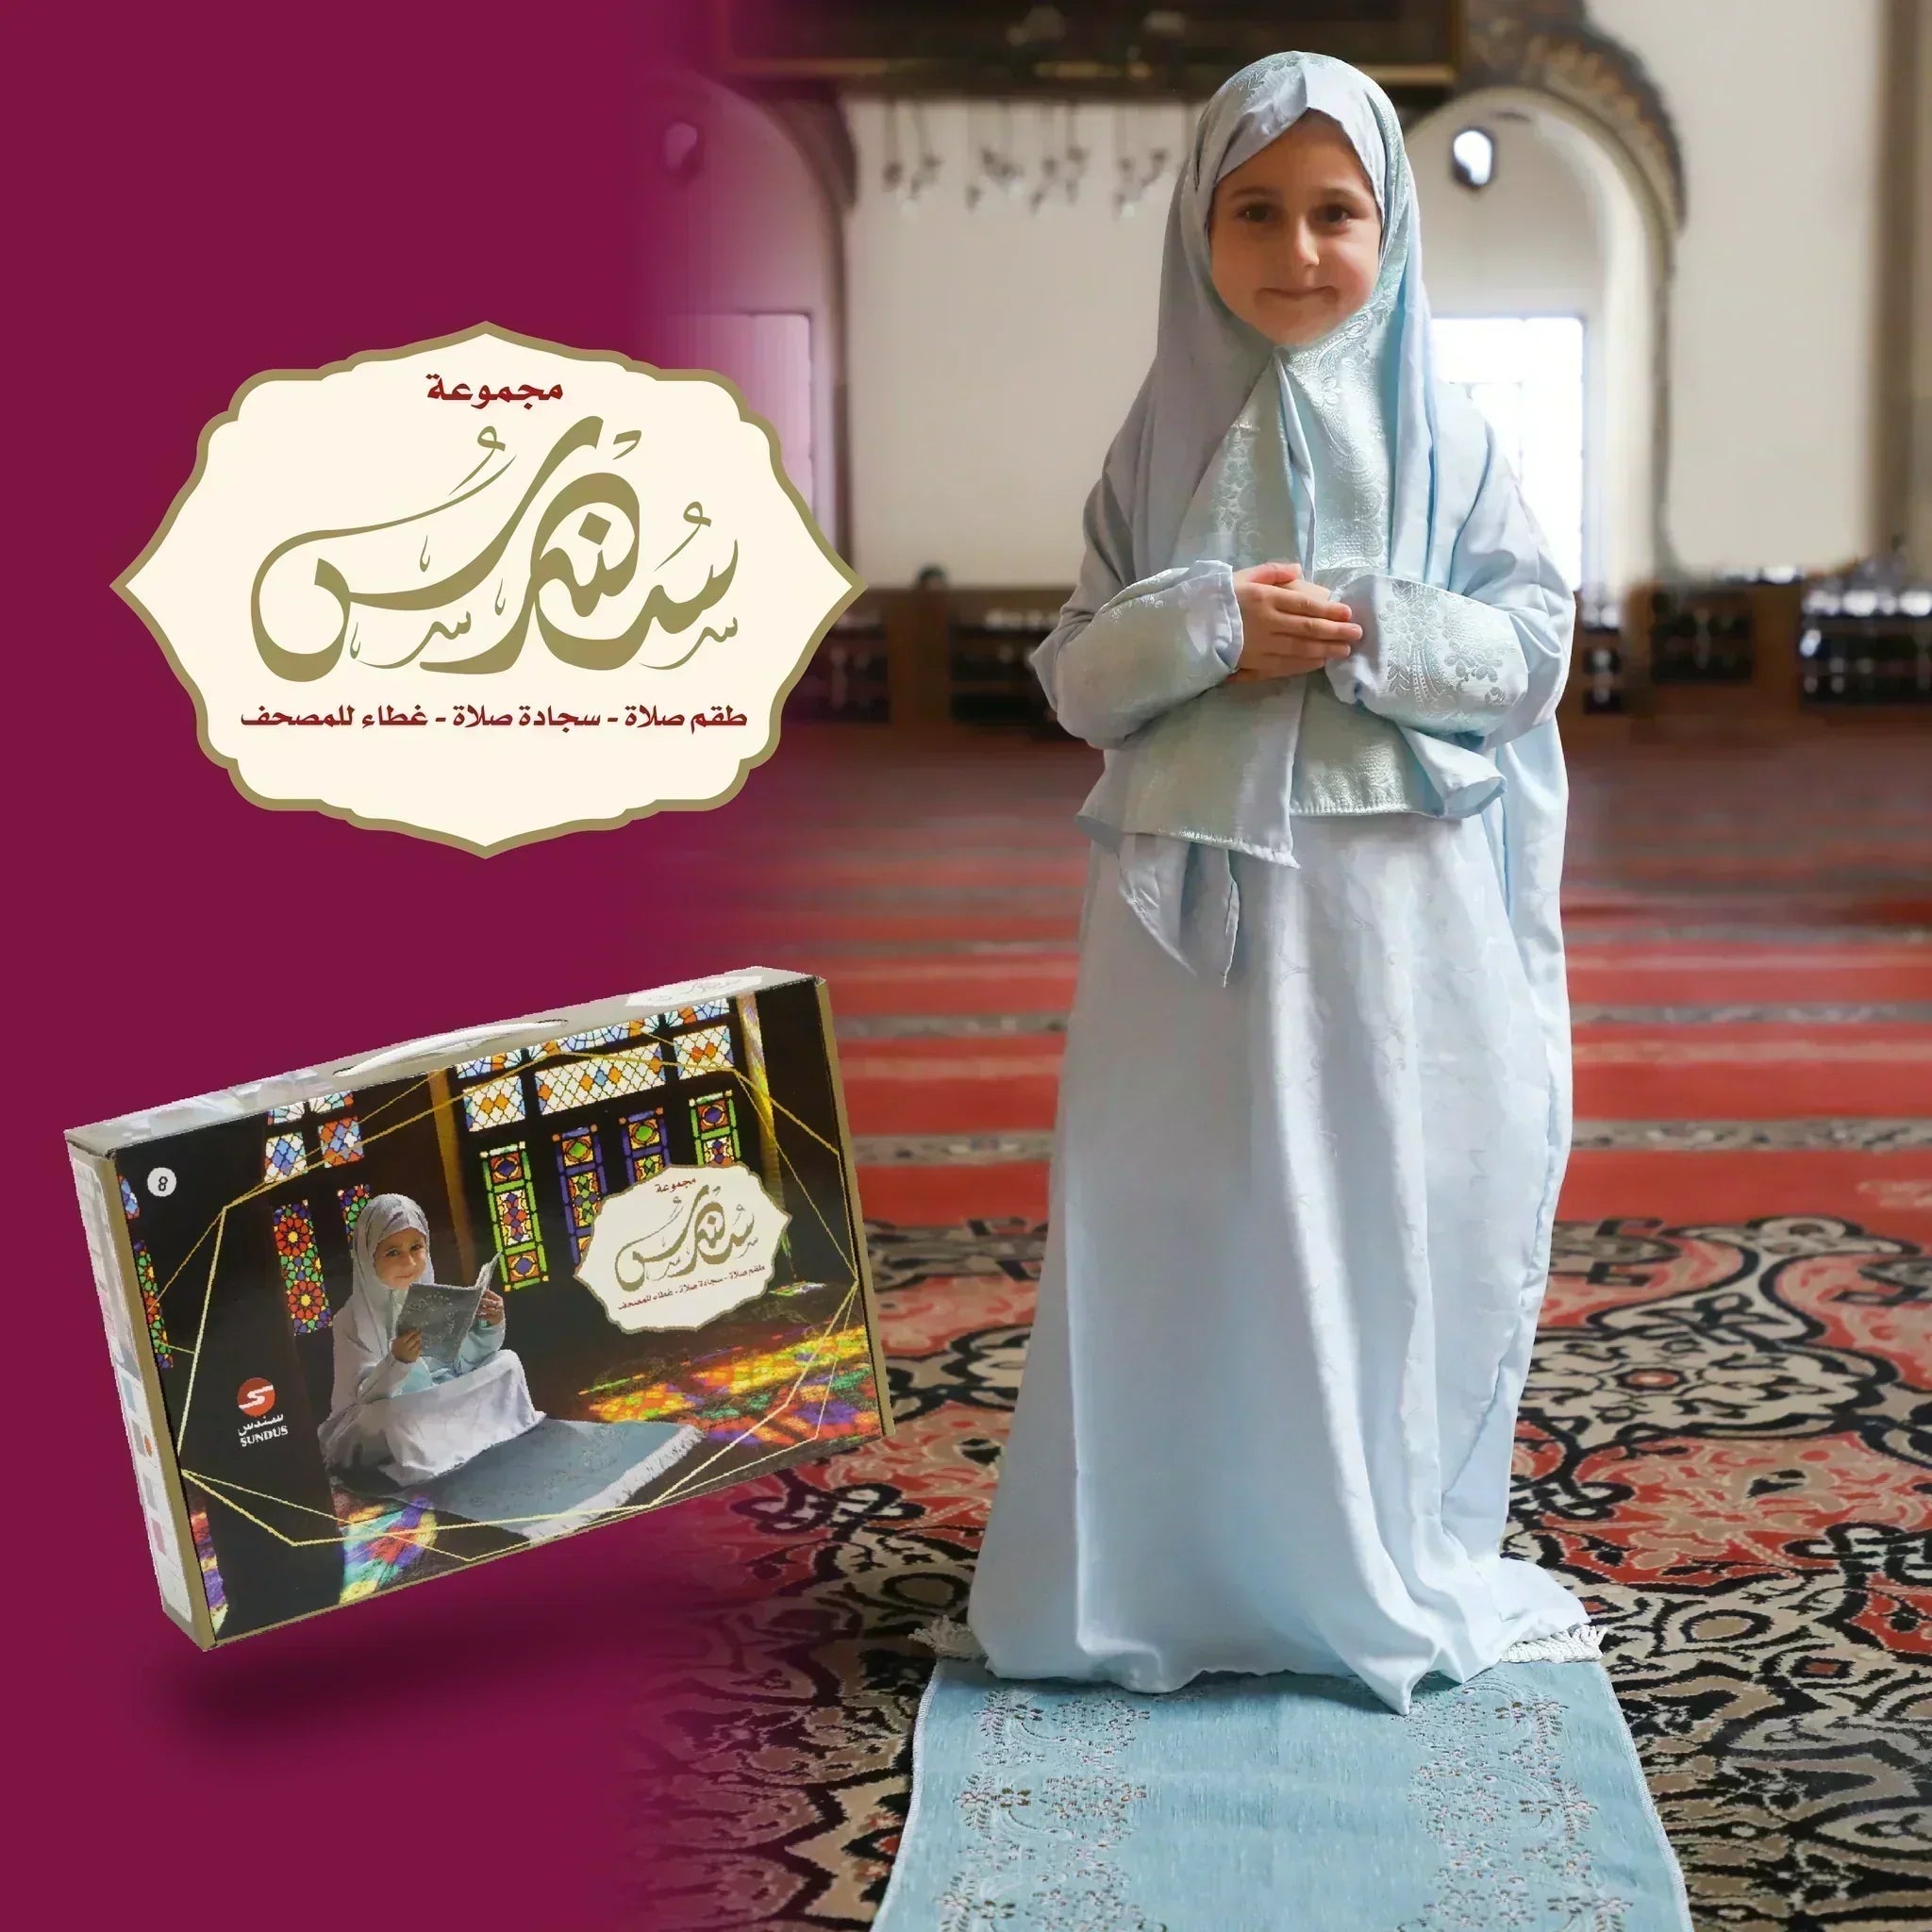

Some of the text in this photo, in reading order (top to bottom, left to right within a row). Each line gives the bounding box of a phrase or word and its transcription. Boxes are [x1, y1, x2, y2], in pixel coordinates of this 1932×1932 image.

[157, 1175, 169, 1192] 8
[655, 1177, 696, 1193] مجموعة
[237, 1414, 284, 1437] سندس
[240, 1425, 289, 1447] SUNDUS
